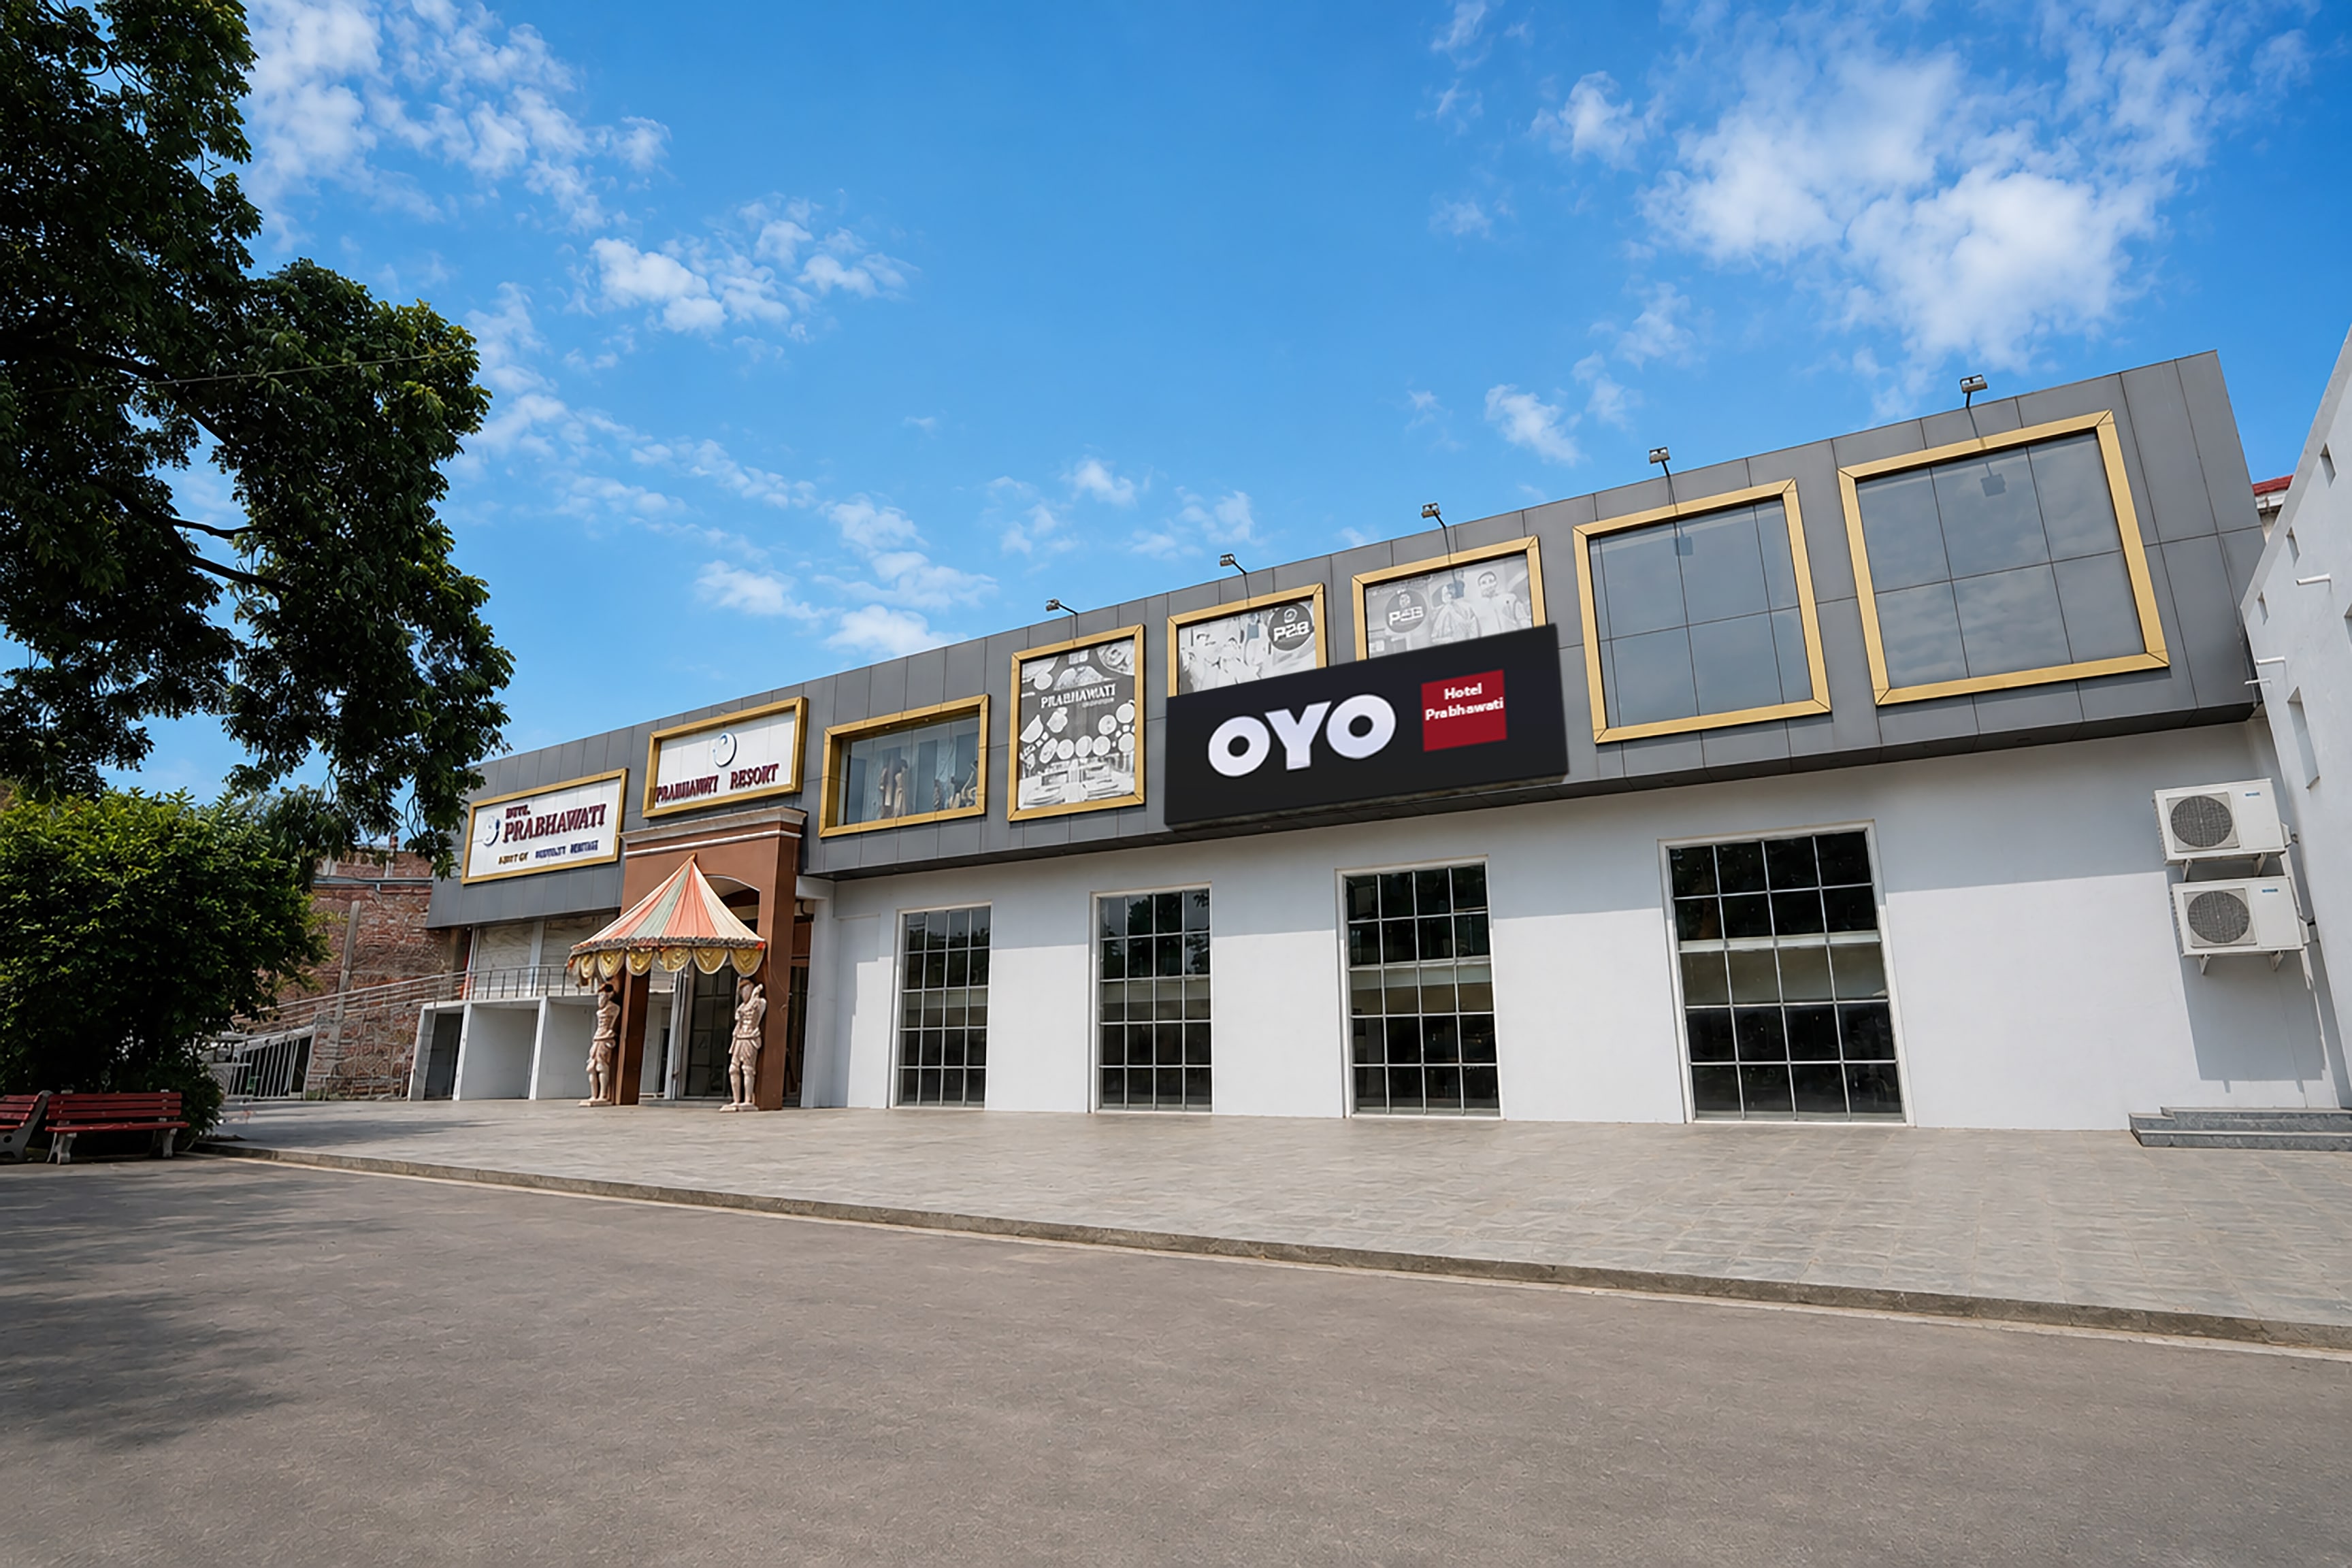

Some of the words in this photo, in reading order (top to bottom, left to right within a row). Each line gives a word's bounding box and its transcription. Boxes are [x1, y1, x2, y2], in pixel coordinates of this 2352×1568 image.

[1444, 683, 1482, 700] Hotel
[1425, 697, 1504, 721] Prabhawati
[1208, 694, 1396, 777] OYO
[730, 764, 779, 790] RESORT
[502, 804, 606, 844] PRABHAWATI
